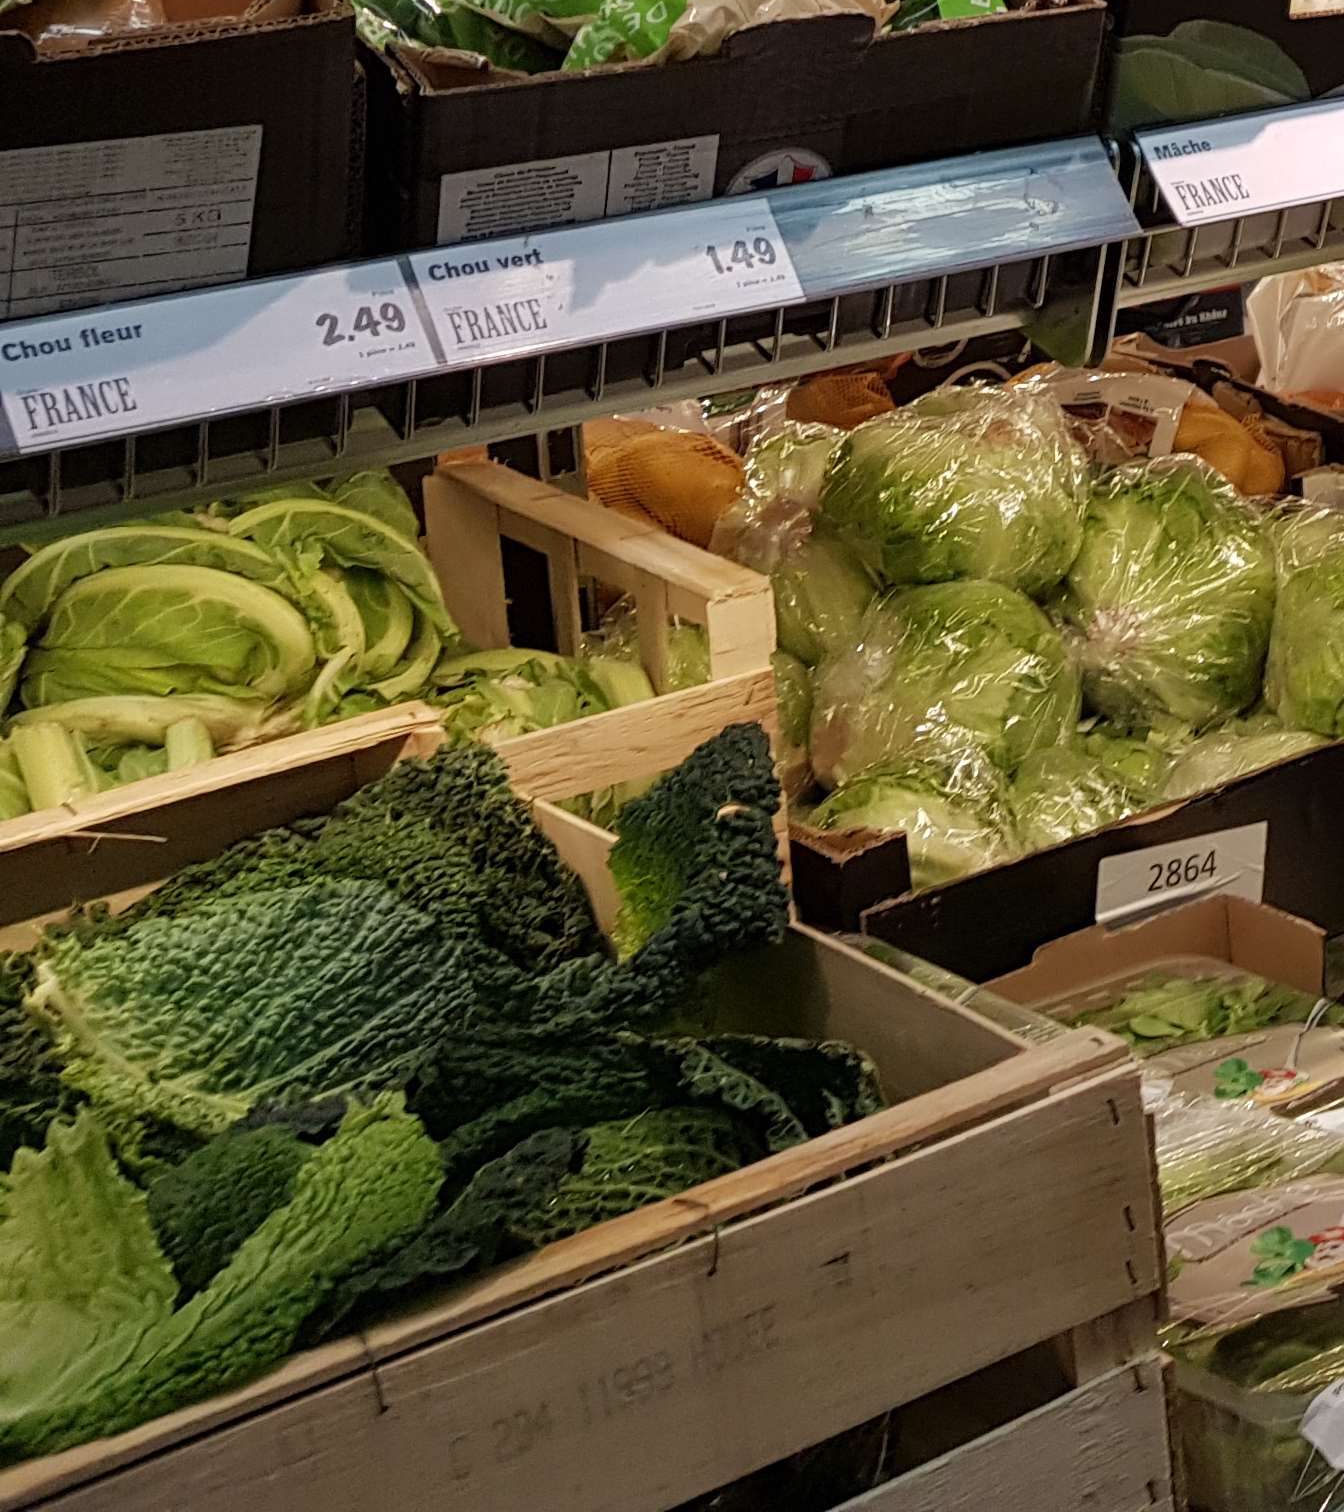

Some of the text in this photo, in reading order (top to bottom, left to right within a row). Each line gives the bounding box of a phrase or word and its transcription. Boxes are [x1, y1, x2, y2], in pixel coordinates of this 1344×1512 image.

[1153, 139, 1212, 160] Mâche
[1175, 173, 1250, 212] FRANCE
[428, 248, 544, 282] Chou vert
[705, 236, 778, 275] 1.49
[315, 302, 406, 346] 2.49
[448, 299, 548, 345] FRANCE
[2, 323, 143, 362] Chou fleur
[21, 376, 138, 431] FRANCE
[1147, 848, 1219, 894] 2864
